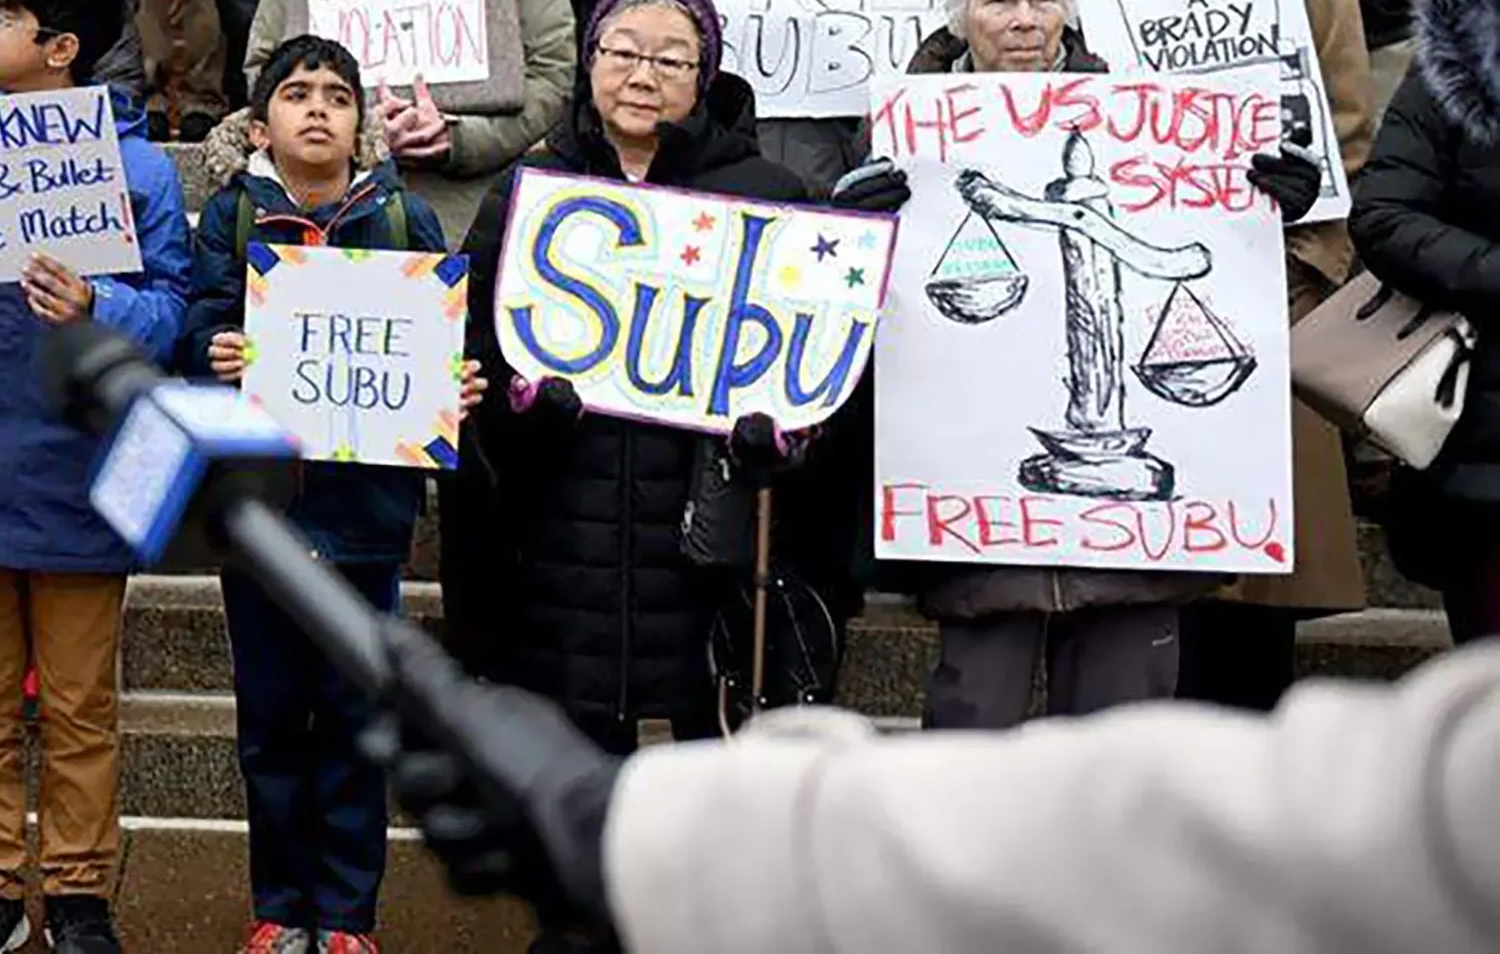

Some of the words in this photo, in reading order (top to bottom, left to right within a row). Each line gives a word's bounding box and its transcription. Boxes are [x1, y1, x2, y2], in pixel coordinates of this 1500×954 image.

[1139, 2, 1253, 47] BRADY
[1142, 24, 1280, 72] VIOLATION
[872, 82, 986, 163] THE
[999, 77, 1100, 137] US
[1107, 82, 1281, 162] JUSTICE
[26, 158, 114, 194] Bullet
[1109, 155, 1280, 213] SYSTE
[506, 195, 870, 417] Subu
[293, 312, 414, 357] FREE
[292, 358, 411, 411] SUBU
[881, 481, 1065, 555] FREE
